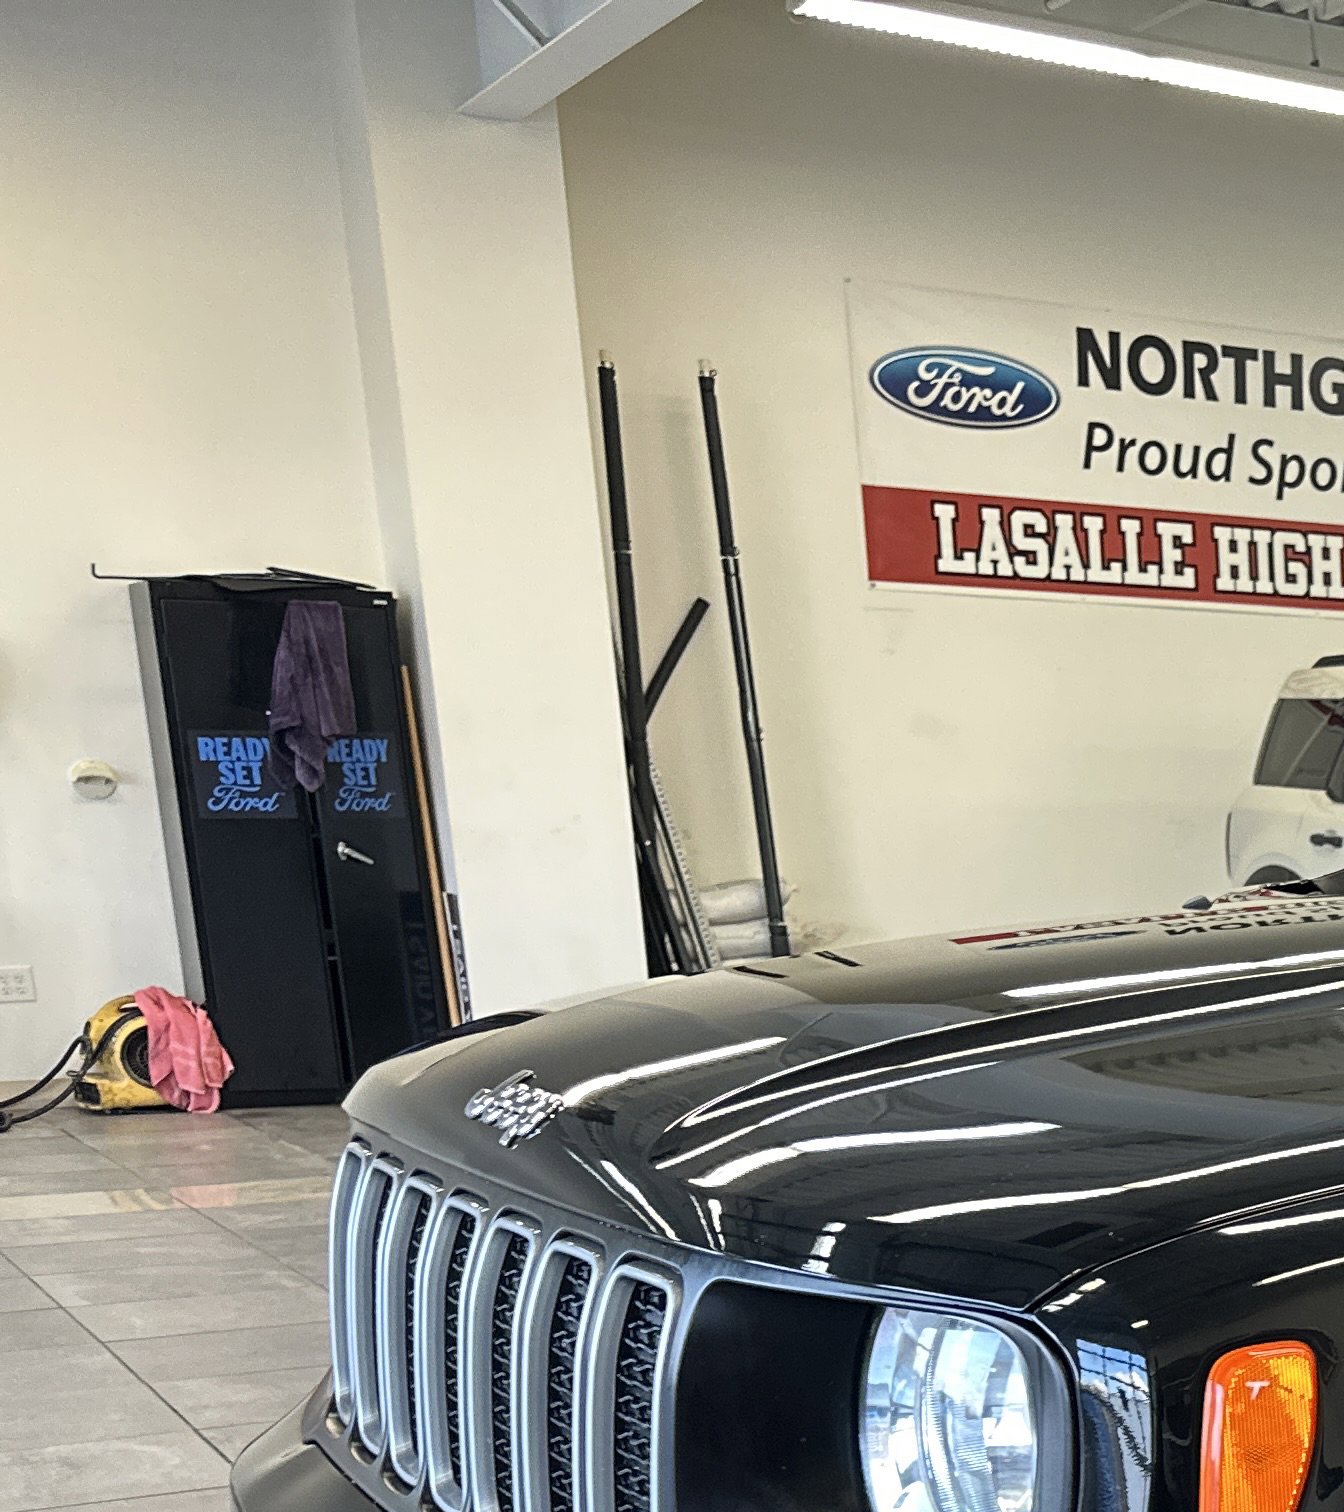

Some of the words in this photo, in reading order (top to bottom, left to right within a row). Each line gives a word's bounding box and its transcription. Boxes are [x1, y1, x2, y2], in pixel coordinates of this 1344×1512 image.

[906, 357, 1025, 417] Ford
[1082, 421, 1236, 482] Proud
[931, 500, 1198, 591] LASALLE
[218, 761, 263, 785] SET
[341, 762, 377, 786] SET
[207, 785, 280, 812] Ford
[334, 785, 393, 812] Ford
